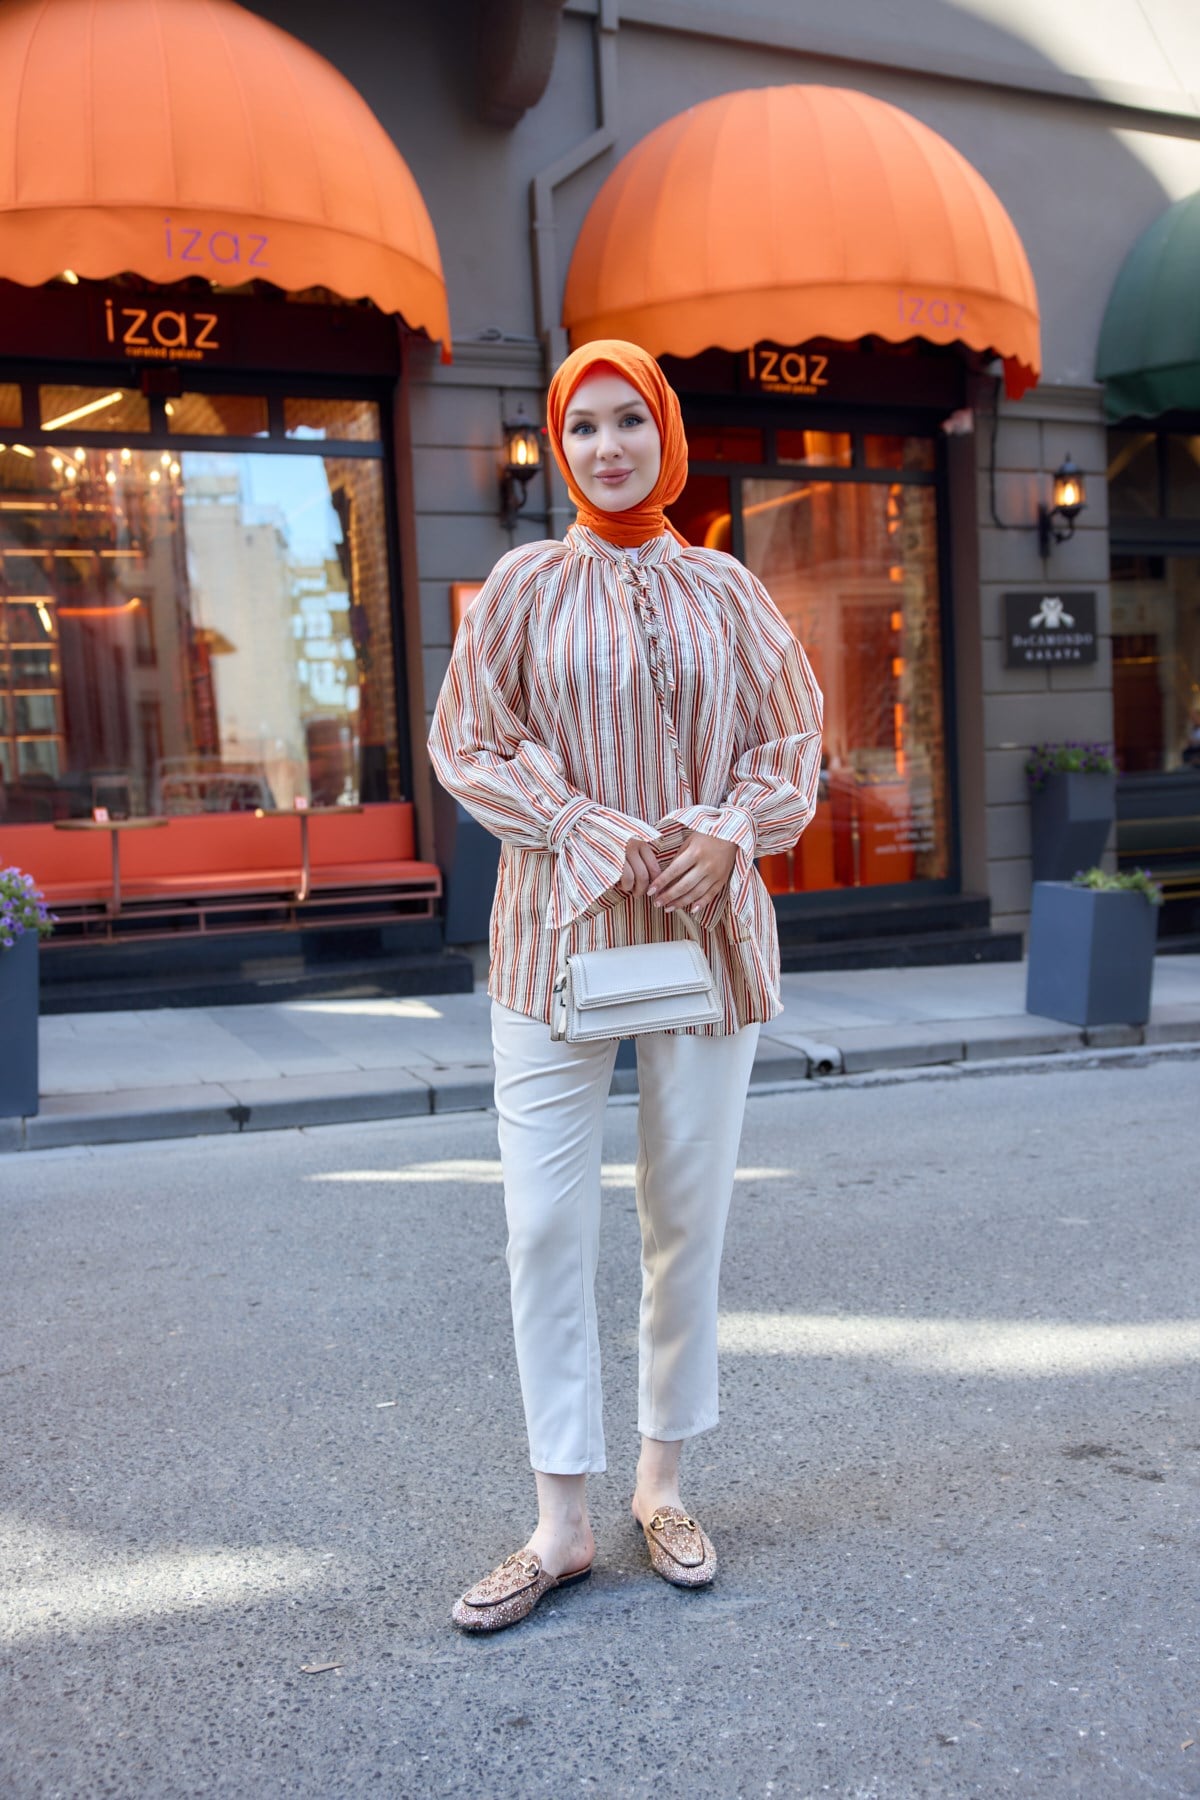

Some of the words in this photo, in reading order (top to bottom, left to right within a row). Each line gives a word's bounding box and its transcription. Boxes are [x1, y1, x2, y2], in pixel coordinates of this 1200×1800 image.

[164, 217, 269, 267] izaz
[105, 299, 219, 349] izaz
[897, 289, 968, 330] izaz
